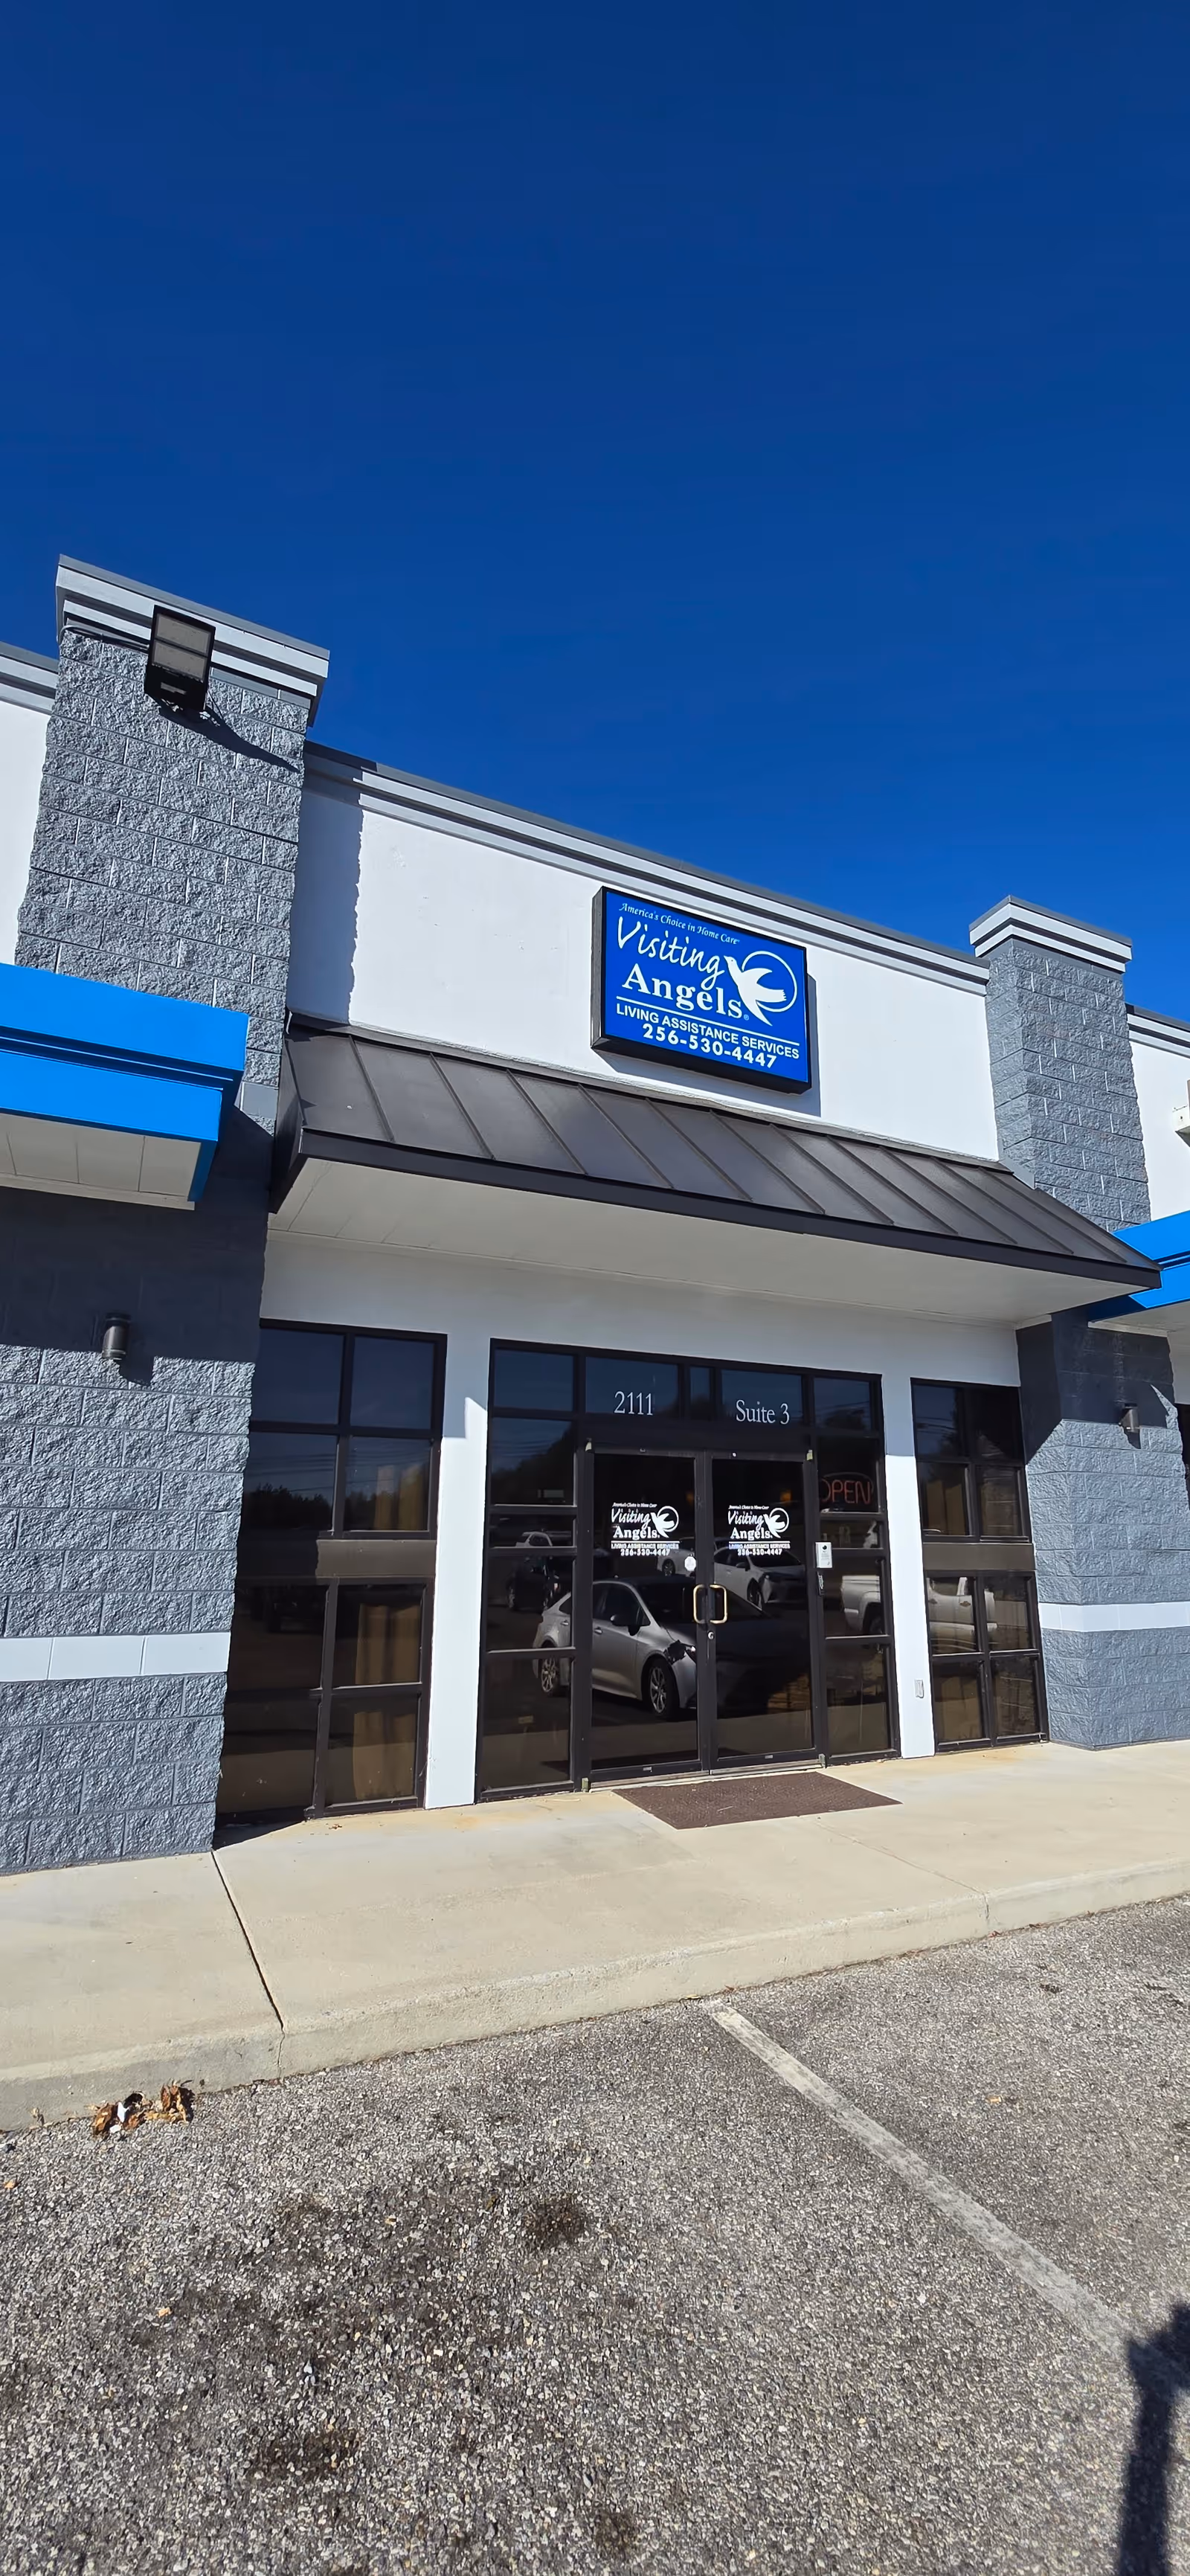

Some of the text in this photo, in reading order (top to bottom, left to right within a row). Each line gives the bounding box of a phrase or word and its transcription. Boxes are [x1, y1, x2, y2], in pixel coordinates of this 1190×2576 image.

[619, 903, 659, 921] America's
[660, 915, 686, 929] Choice
[687, 922, 695, 932] in
[697, 926, 718, 939] Home
[617, 916, 725, 991] Visiting
[616, 1003, 800, 1060] LIVING ASSISTANCE SERVICES
[643, 1023, 776, 1069] 256-530-4447
[614, 1391, 653, 1416] 2111
[736, 1399, 790, 1424] Suite 3
[611, 1509, 651, 1530] Visiting
[727, 1510, 764, 1532] Visiting
